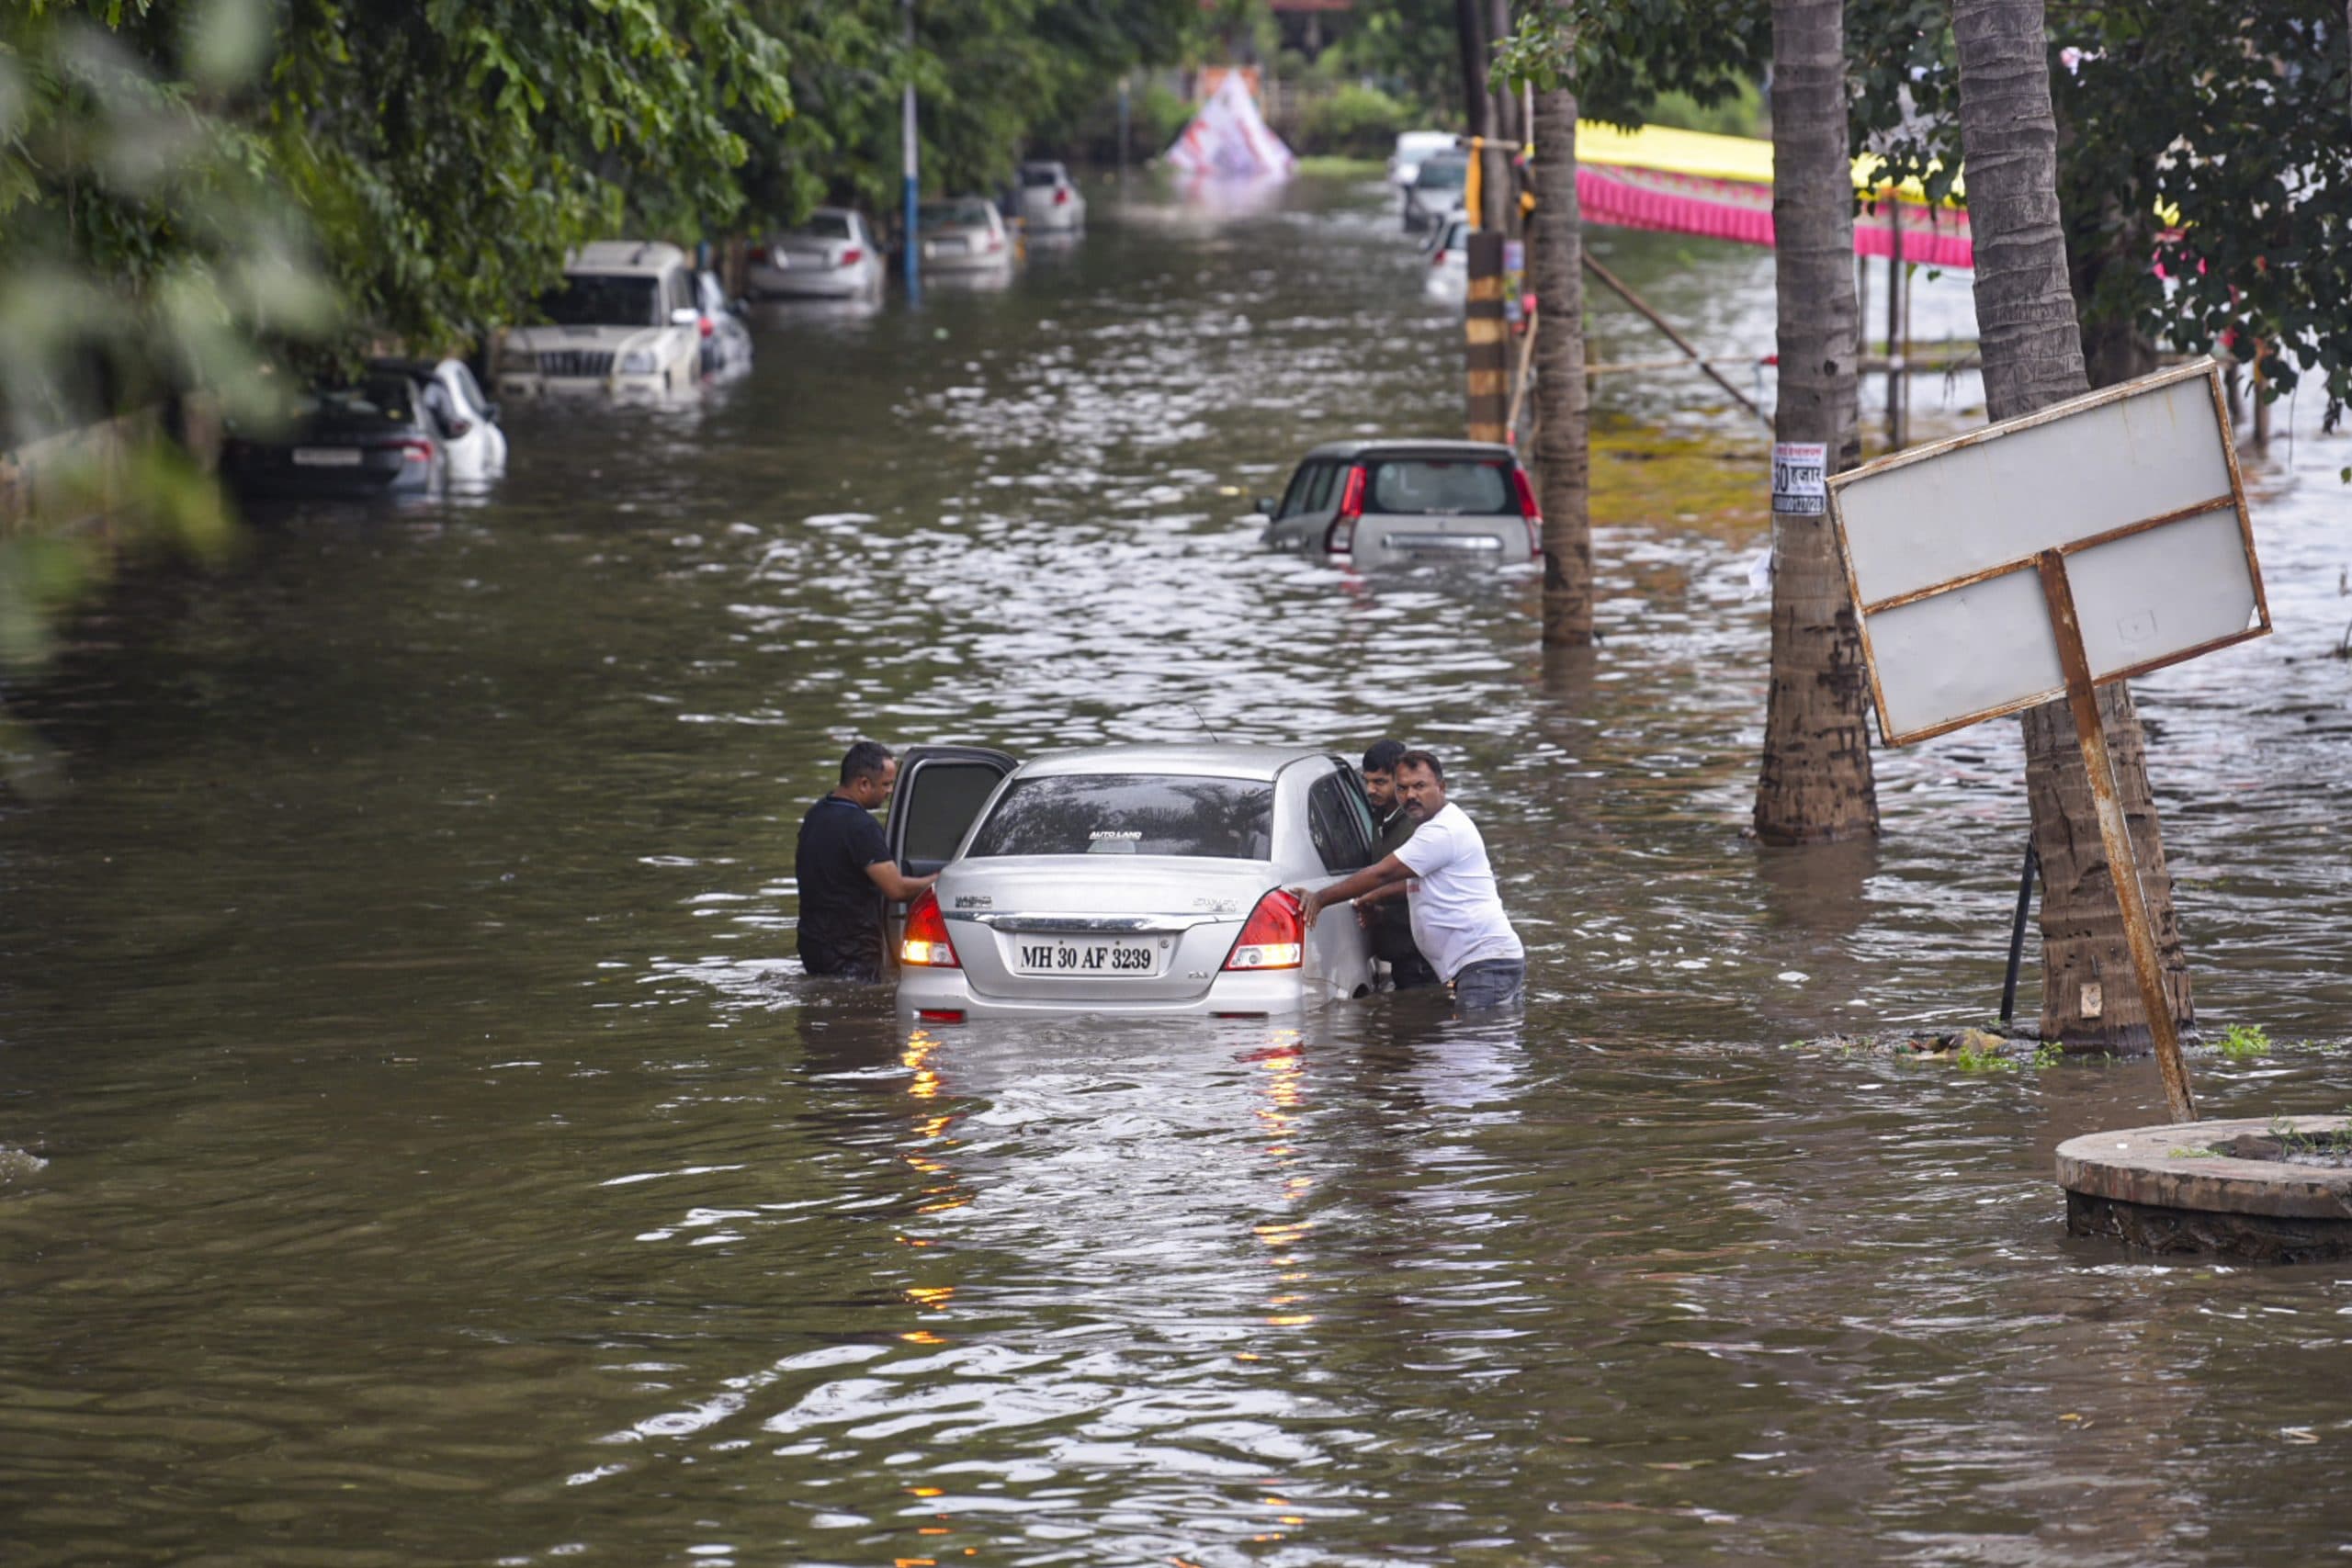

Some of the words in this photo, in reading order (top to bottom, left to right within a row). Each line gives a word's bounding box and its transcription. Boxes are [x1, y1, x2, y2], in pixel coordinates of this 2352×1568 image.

[1790, 466, 1822, 485] हजार
[1088, 830, 1115, 840] AUTO
[1021, 946, 1053, 968] MH
[1057, 947, 1077, 968] 30
[1081, 947, 1108, 969] AF
[1112, 948, 1151, 969] 3239
